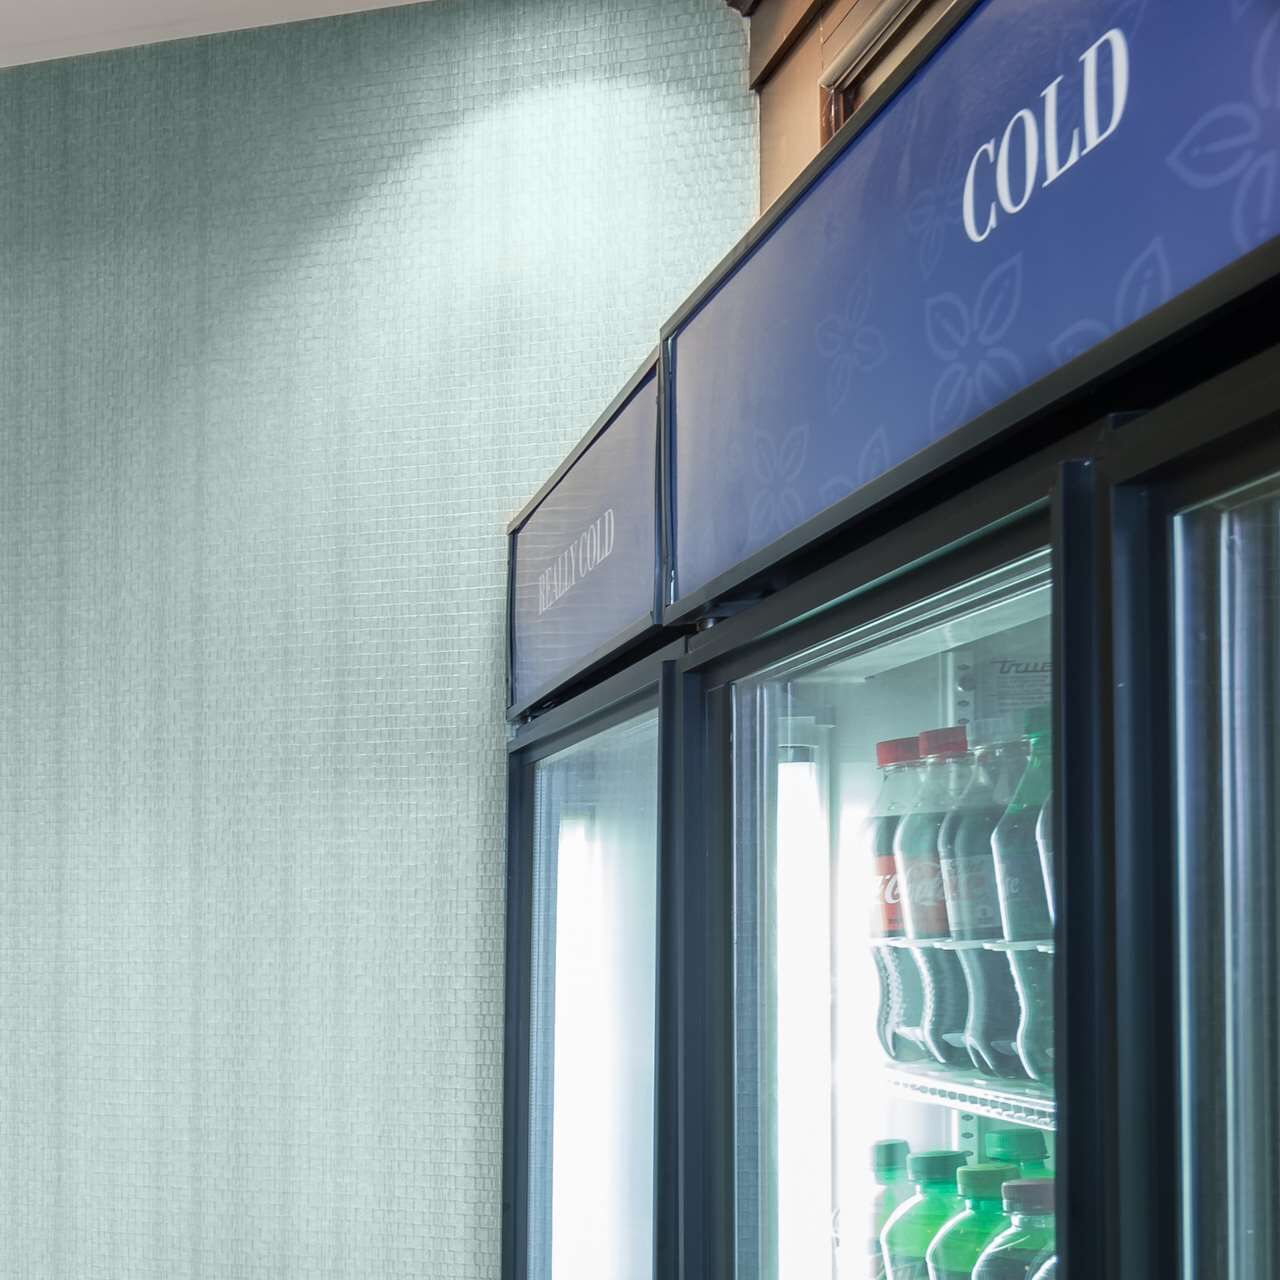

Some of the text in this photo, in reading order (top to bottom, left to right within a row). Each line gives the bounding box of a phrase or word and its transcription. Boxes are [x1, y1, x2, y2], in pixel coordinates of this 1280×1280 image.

[963, 28, 1129, 243] COLD
[539, 508, 614, 615] REALLY COLD
